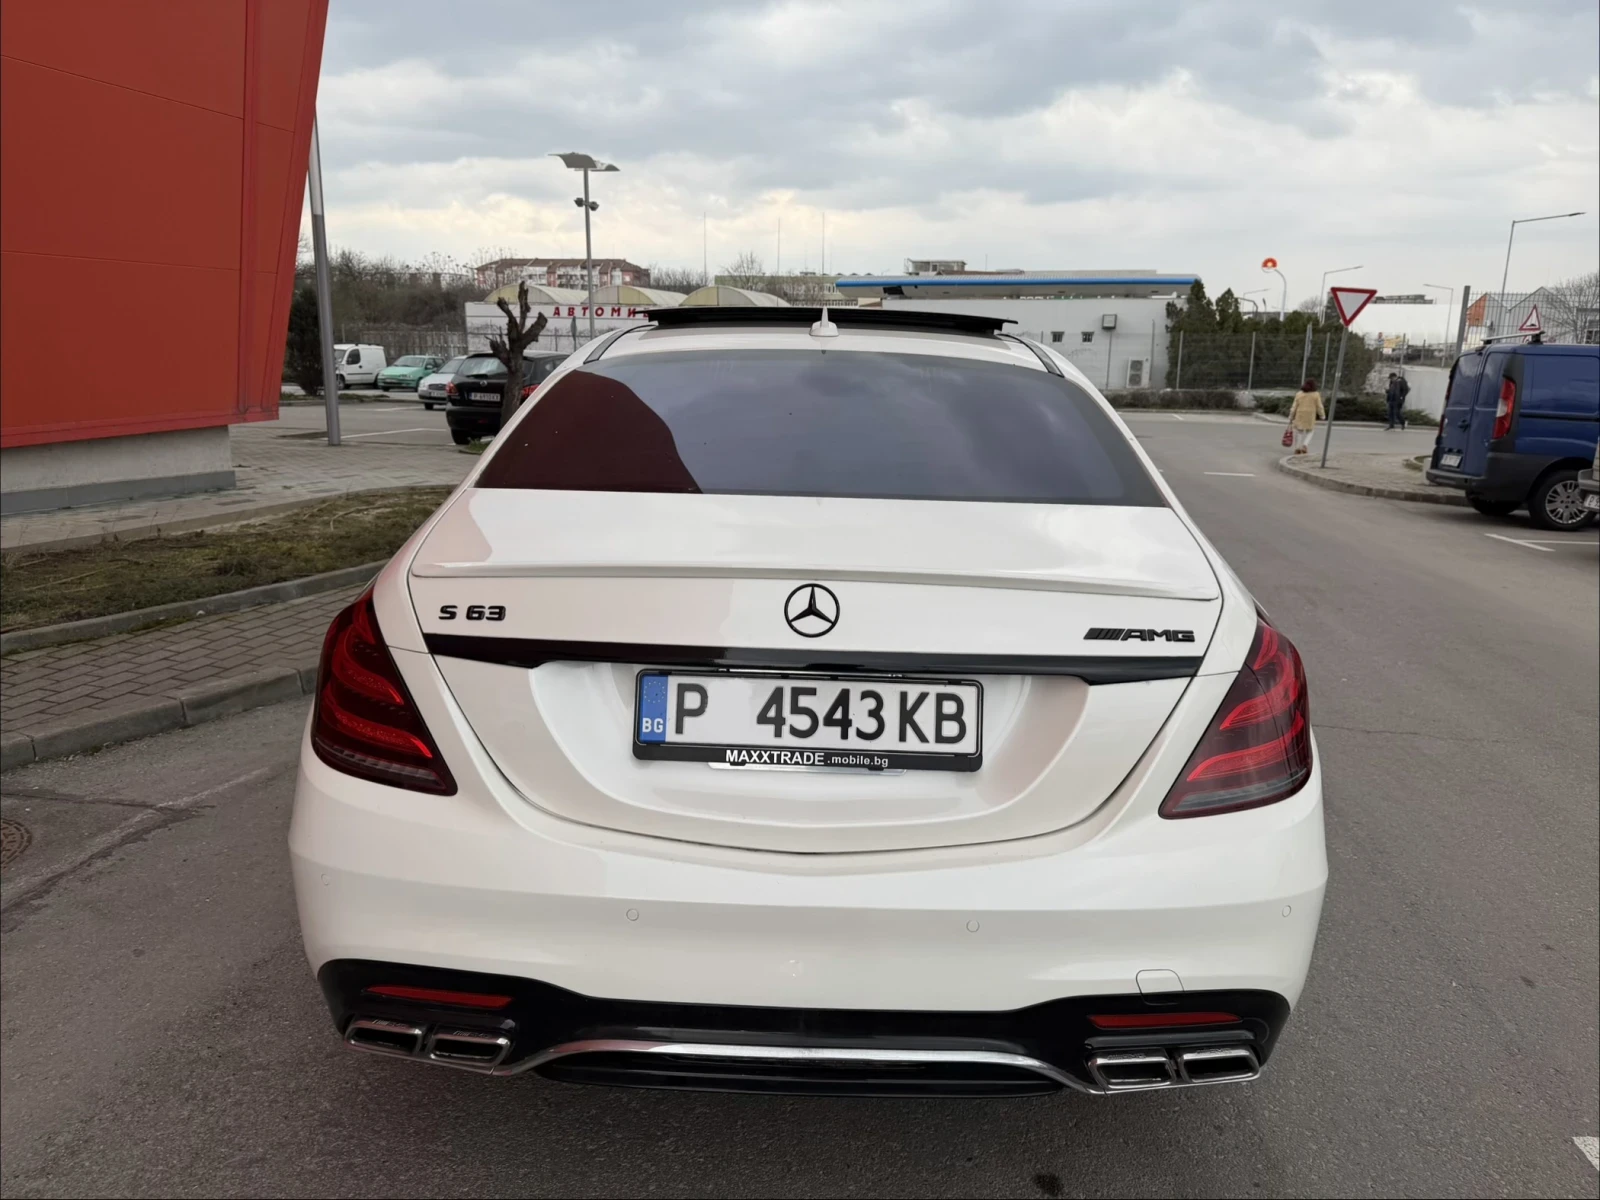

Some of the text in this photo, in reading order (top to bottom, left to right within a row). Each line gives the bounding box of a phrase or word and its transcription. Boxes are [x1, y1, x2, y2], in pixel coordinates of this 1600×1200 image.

[438, 605, 506, 621] S 63
[1120, 628, 1195, 642] AMG
[675, 683, 708, 735] P
[642, 717, 664, 733] BG
[725, 750, 825, 765] MAXXTRADE
